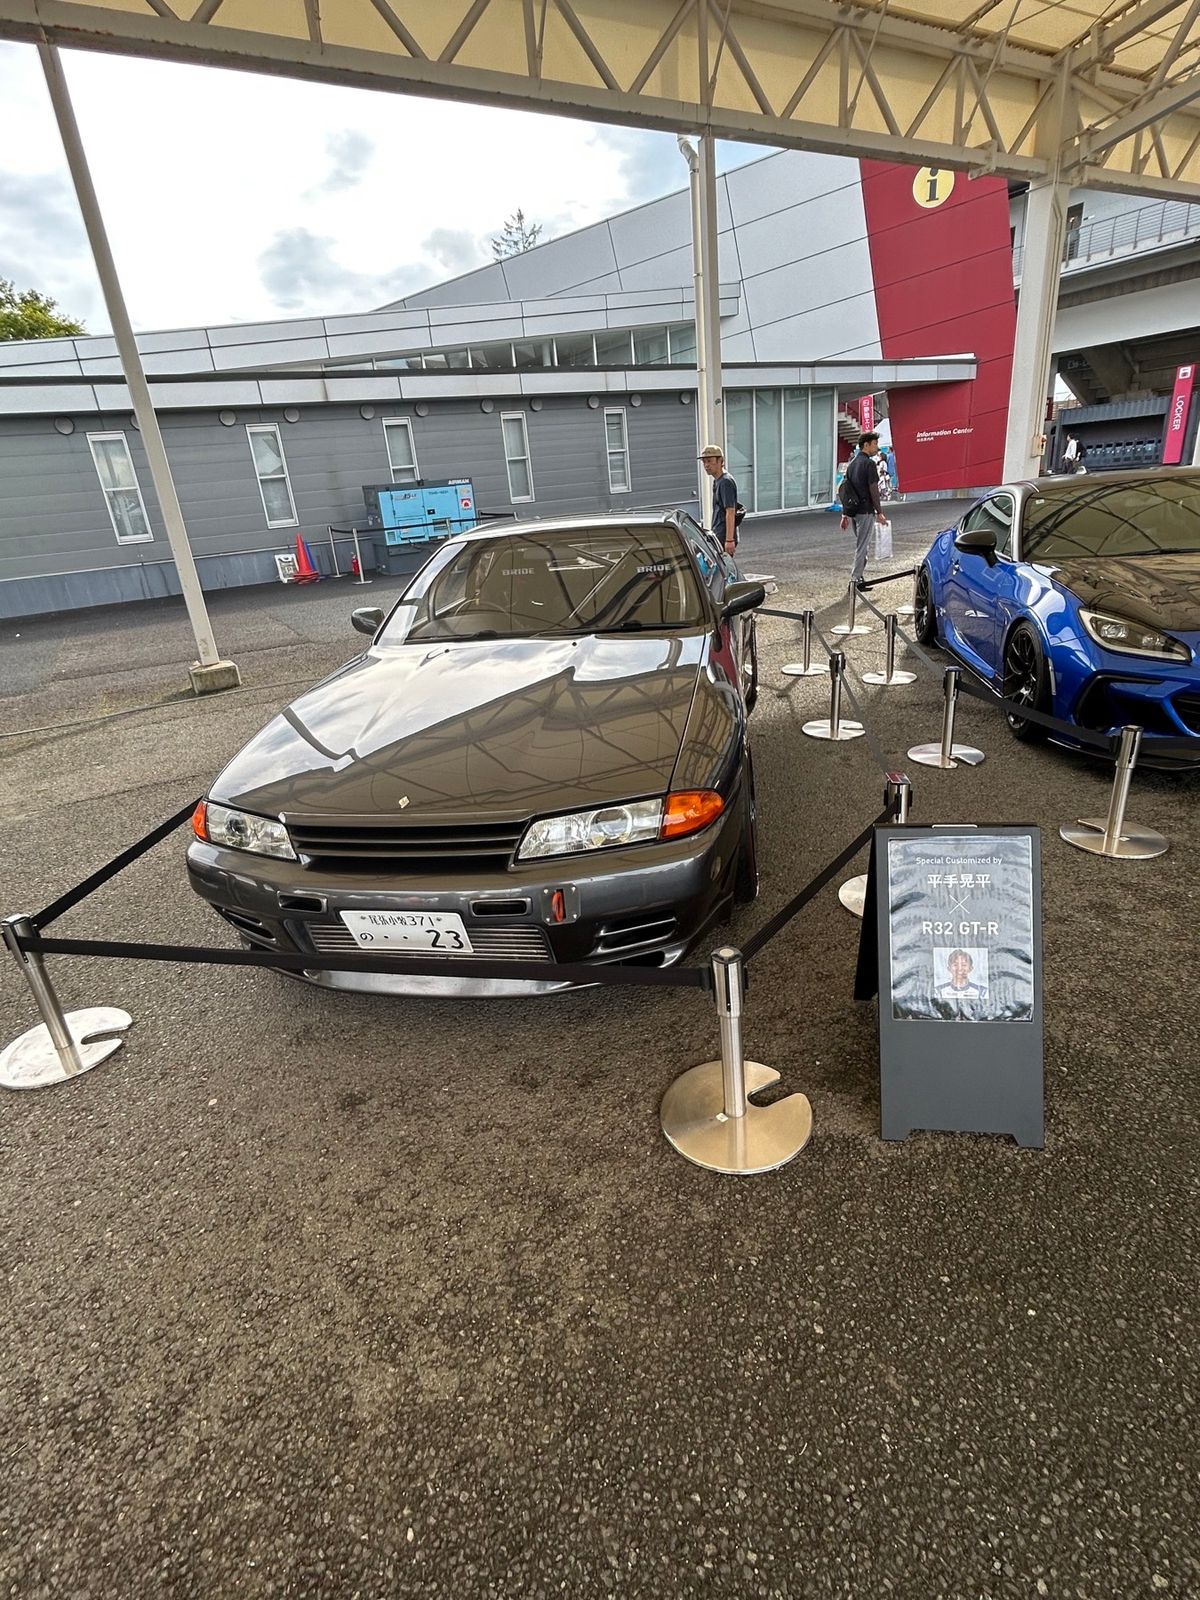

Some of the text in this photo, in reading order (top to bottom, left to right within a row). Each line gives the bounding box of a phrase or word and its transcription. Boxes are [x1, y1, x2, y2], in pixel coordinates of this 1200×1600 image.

[1172, 395, 1185, 431] LOCKER
[916, 427, 974, 438] Information Center
[502, 567, 535, 576] BRIDE
[636, 563, 672, 574] BRIDE
[916, 856, 1003, 866] Special Customized by
[927, 873, 991, 889] 平手晃平
[922, 921, 999, 935] R32 GT-R
